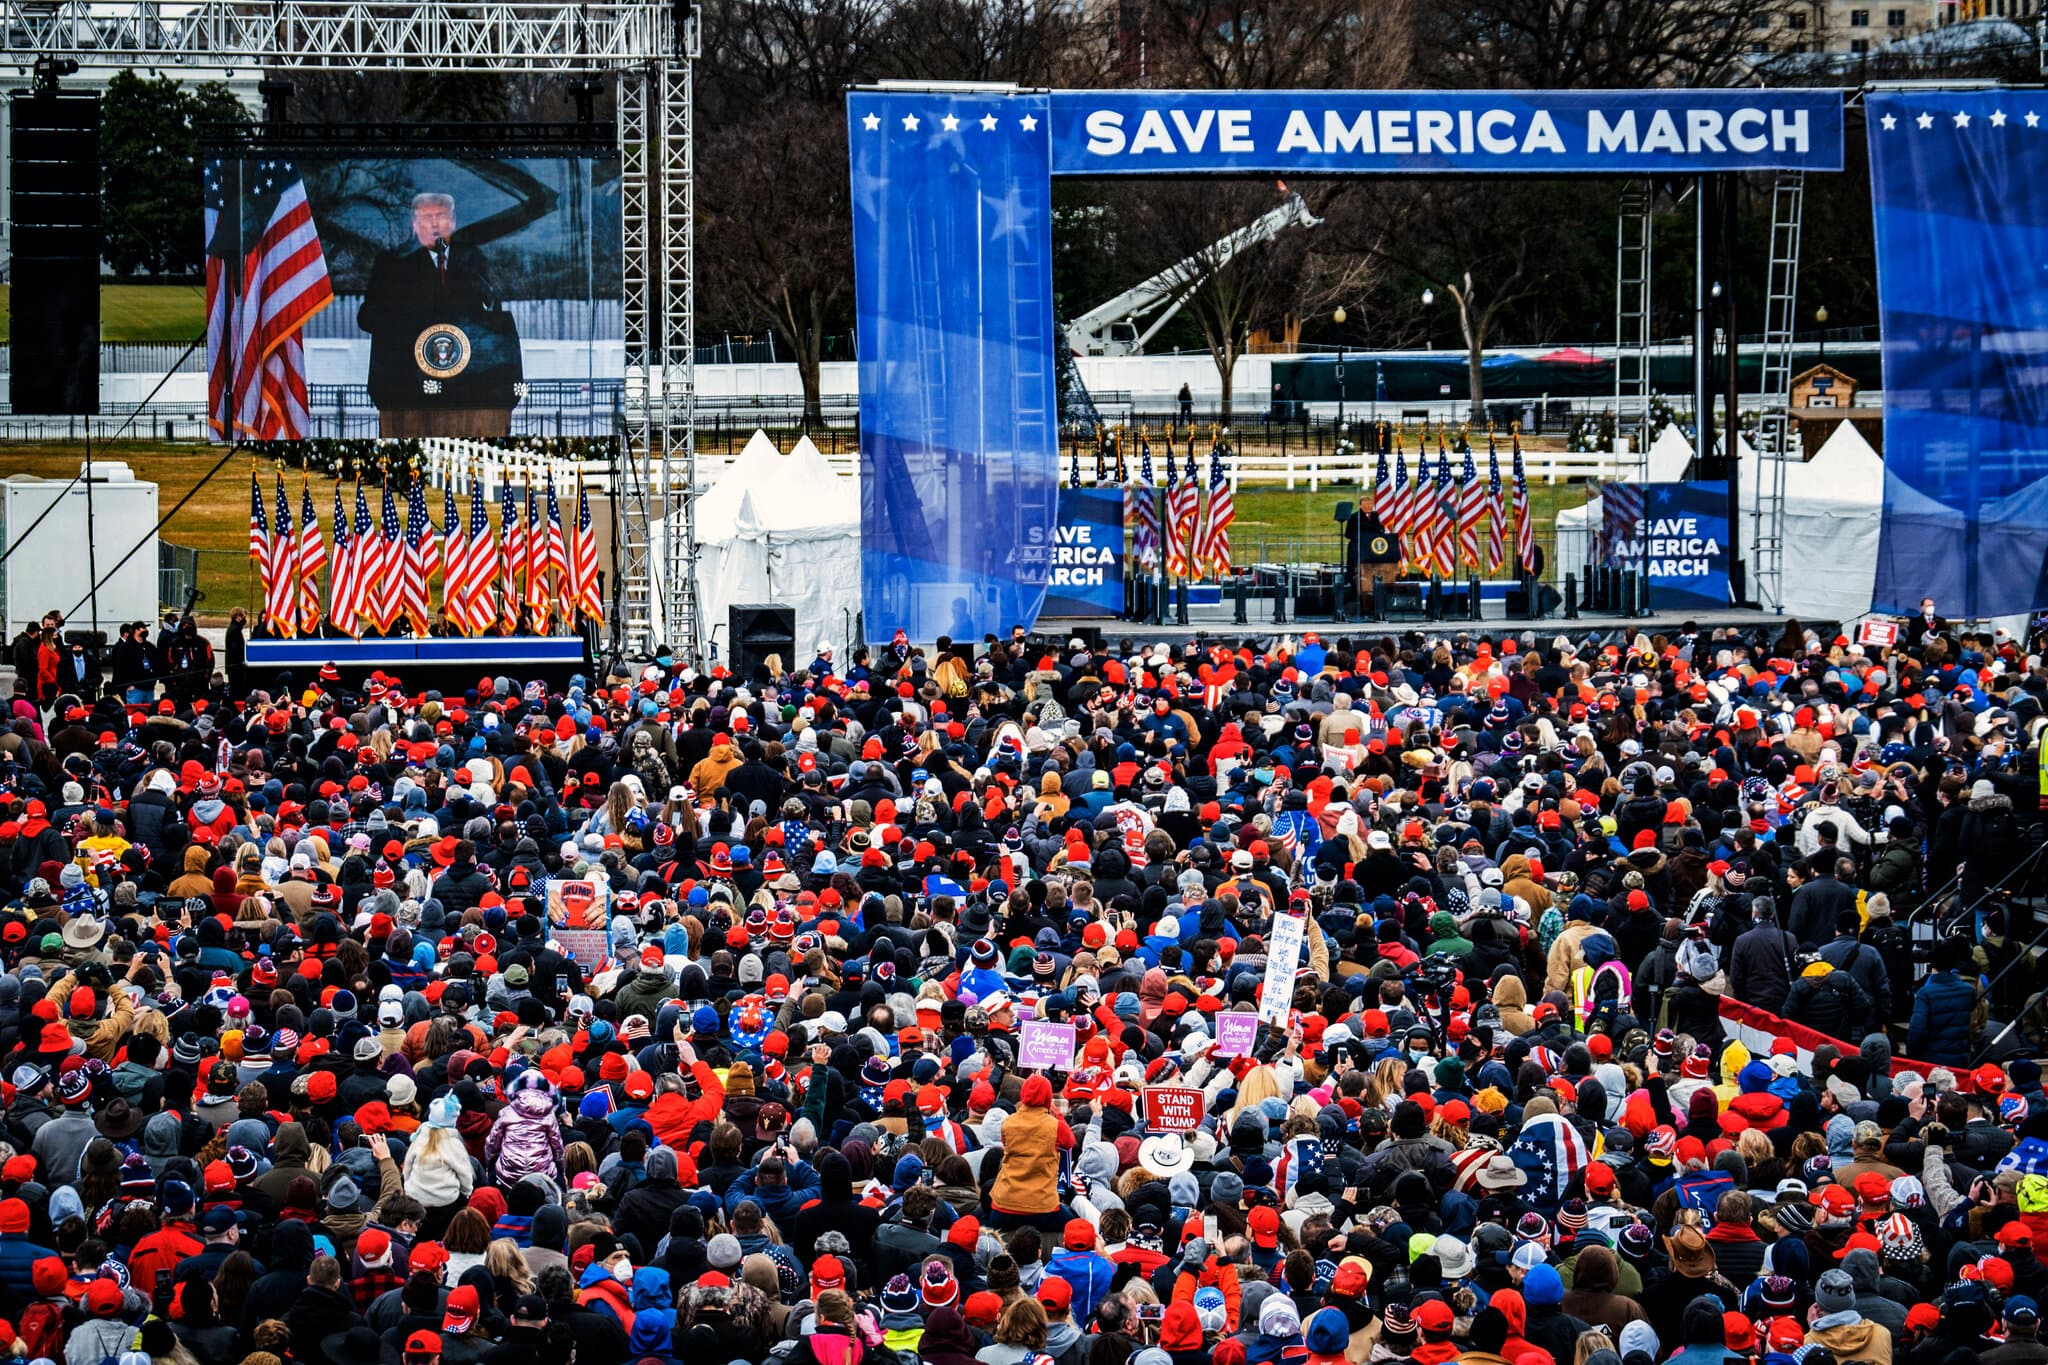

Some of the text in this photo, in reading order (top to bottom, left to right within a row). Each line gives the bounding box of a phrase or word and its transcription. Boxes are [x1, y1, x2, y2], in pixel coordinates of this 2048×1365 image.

[1085, 107, 1810, 156] SAVE AMERICA MARCH
[1028, 525, 1091, 543] SAVE
[1634, 518, 1697, 536] SAVE
[1004, 546, 1116, 565] AMERICA
[1614, 538, 1720, 556] AMERICA
[1015, 567, 1103, 586] MARCH
[1623, 559, 1709, 577] MARCH
[1223, 1018, 1252, 1033] Women
[1031, 1027, 1069, 1044] Women
[1157, 1093, 1194, 1105] STAND
[1162, 1105, 1191, 1116] WITH
[1158, 1116, 1196, 1128] TRUMP
